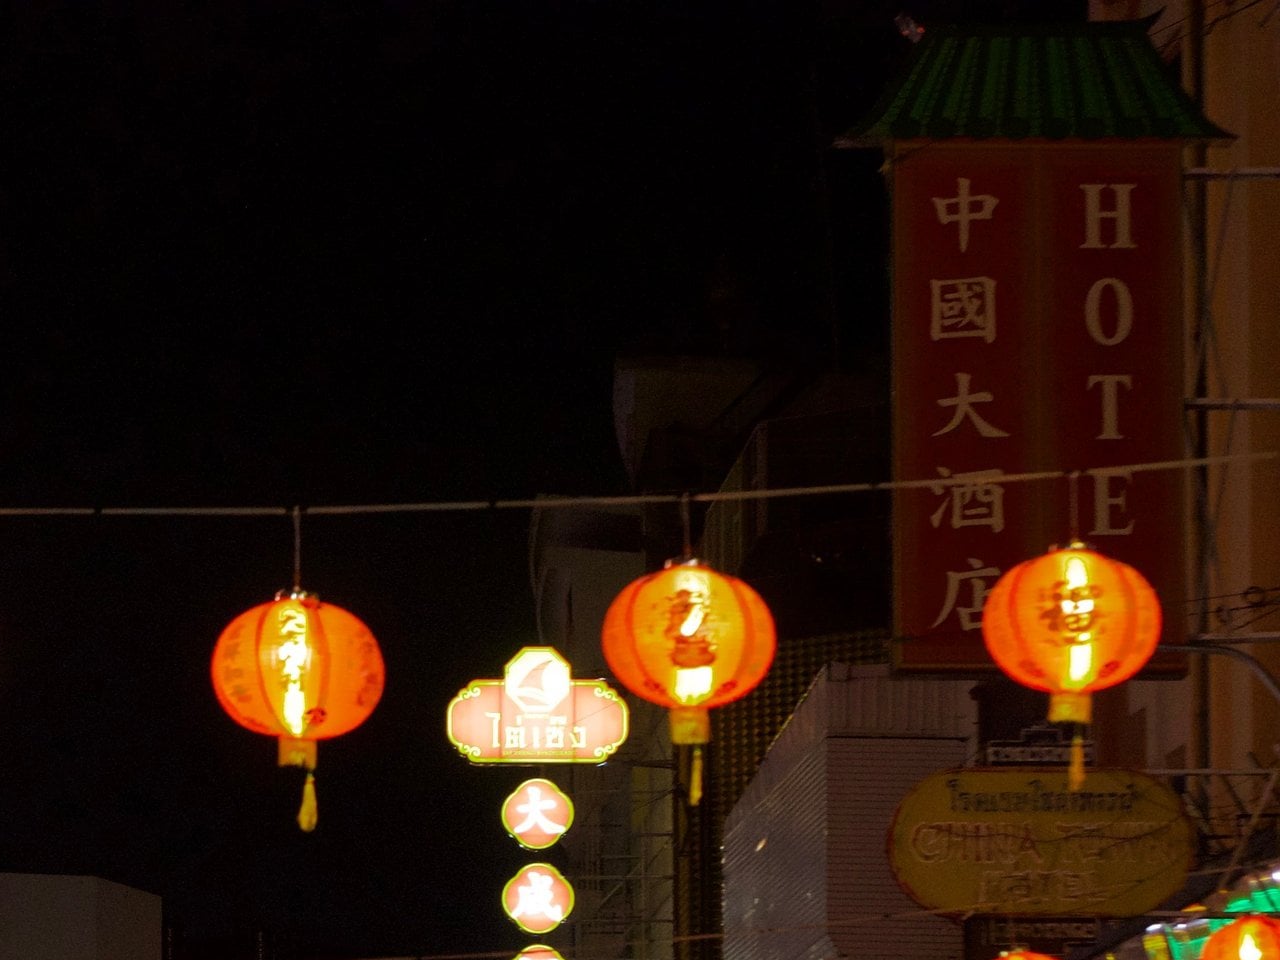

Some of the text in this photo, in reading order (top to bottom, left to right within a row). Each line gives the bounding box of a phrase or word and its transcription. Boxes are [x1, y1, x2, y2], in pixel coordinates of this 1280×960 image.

[928, 176, 1010, 632] 中國大酒店
[1079, 182, 1138, 537] HOTE
